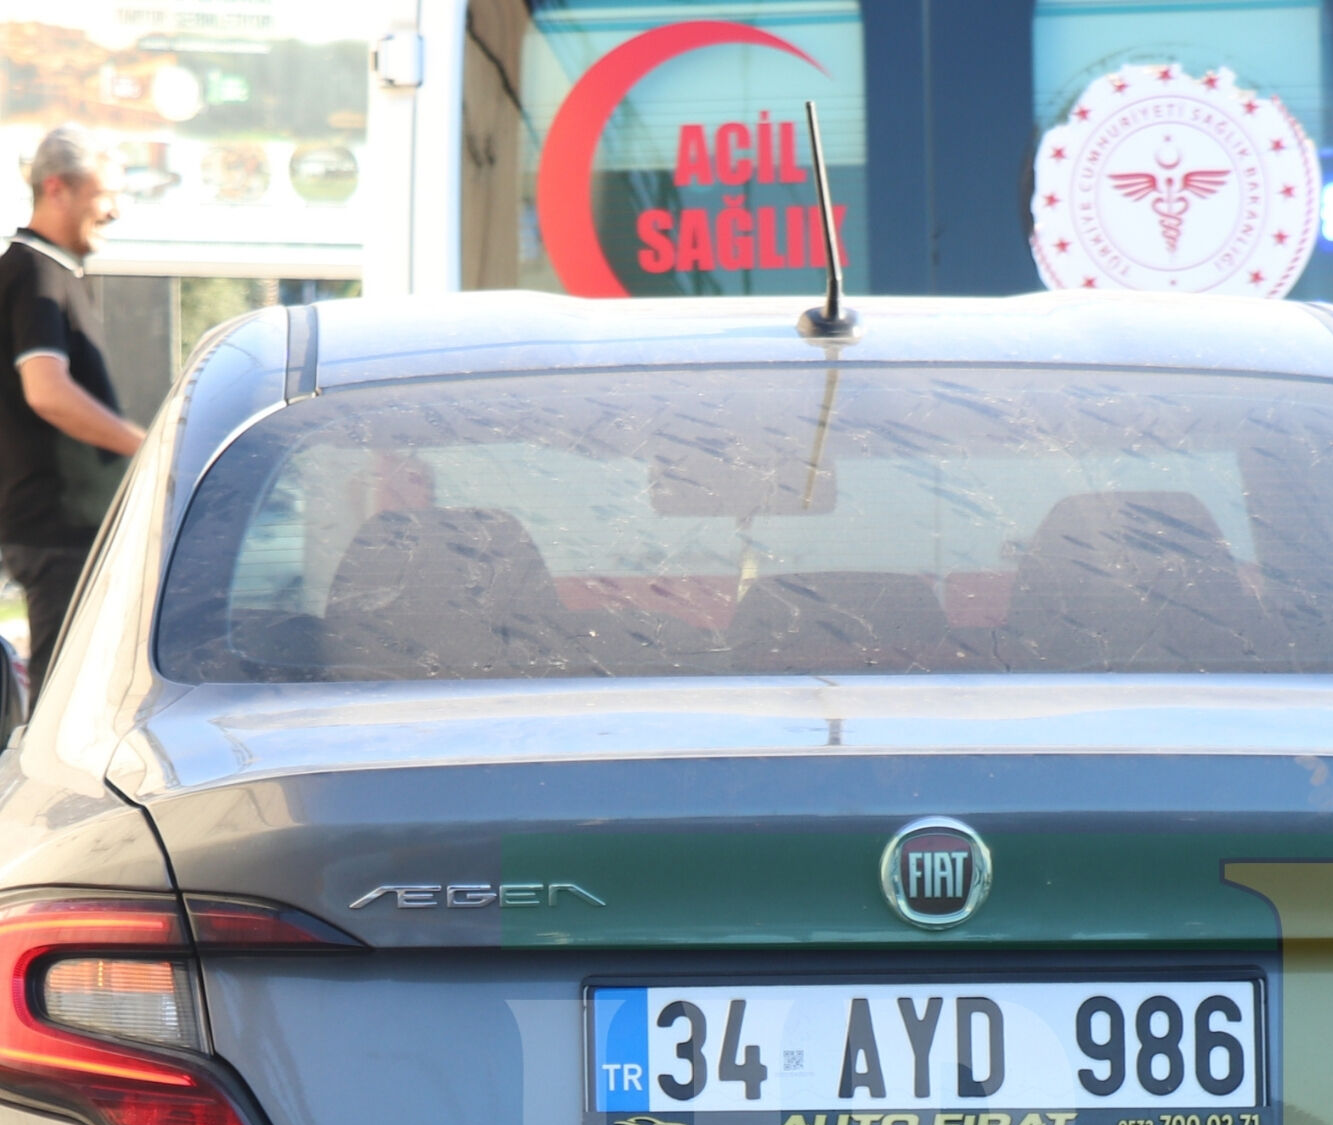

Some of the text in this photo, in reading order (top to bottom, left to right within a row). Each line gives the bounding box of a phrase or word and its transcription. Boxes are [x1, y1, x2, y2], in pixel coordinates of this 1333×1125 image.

[673, 110, 807, 187] ACİL
[636, 194, 850, 274] SAĞLIK
[908, 851, 968, 898] FIAT
[602, 1064, 643, 1091] TR
[657, 995, 1245, 1101] 34 AYD 986
